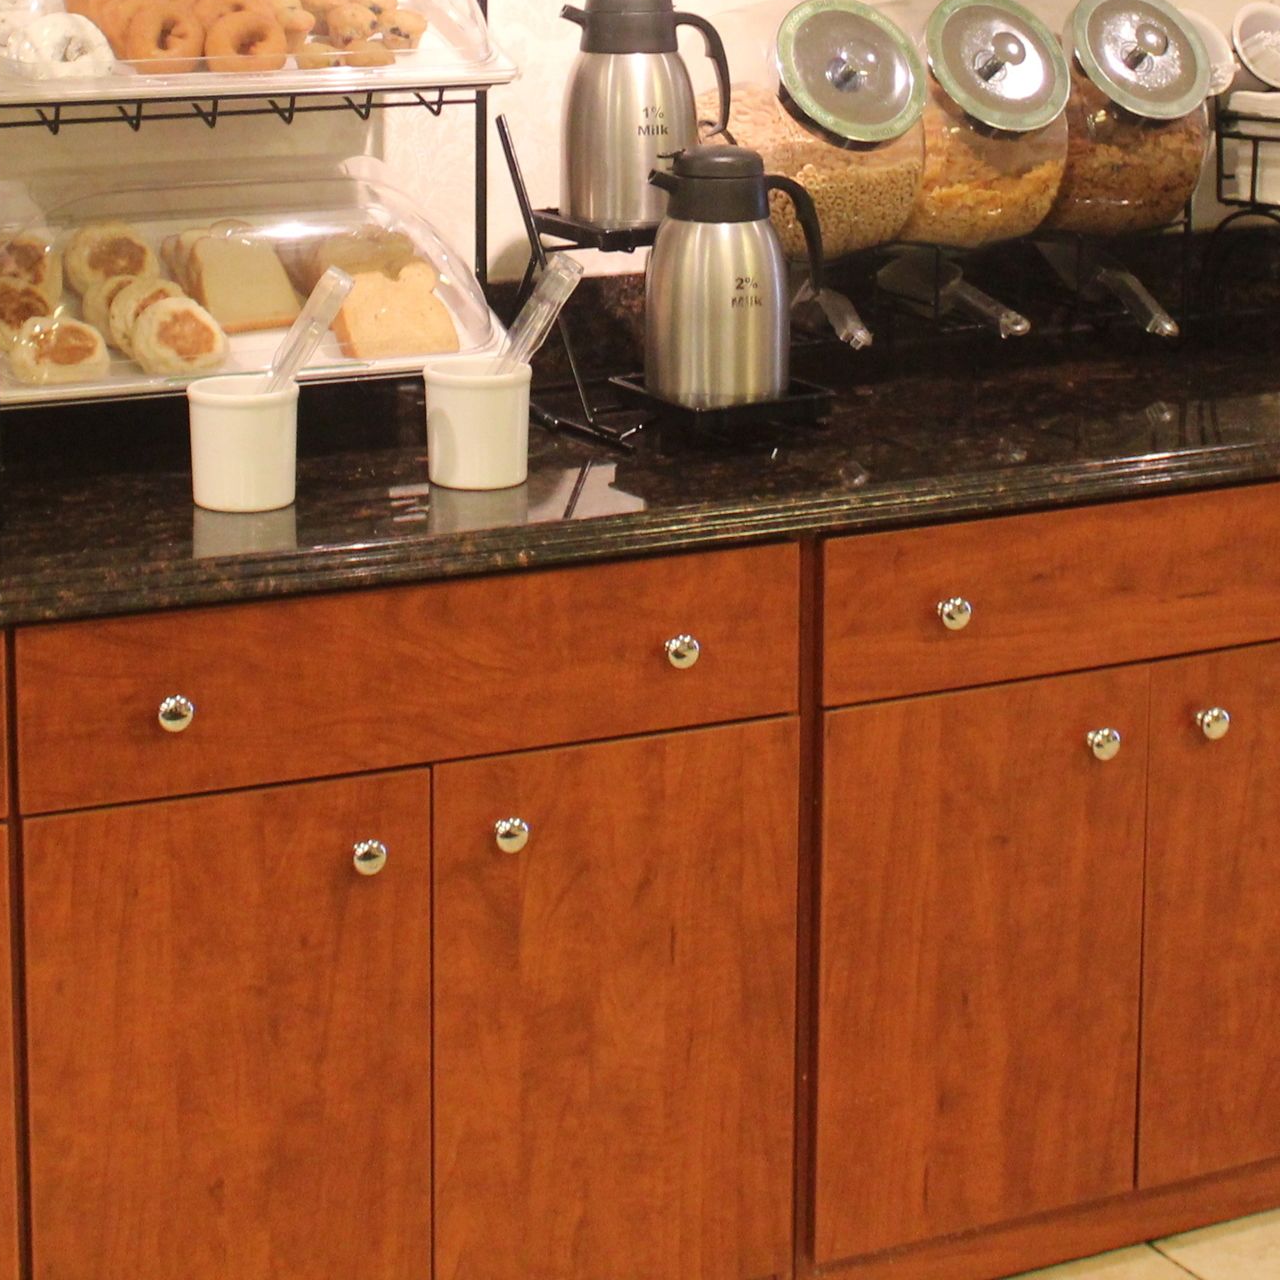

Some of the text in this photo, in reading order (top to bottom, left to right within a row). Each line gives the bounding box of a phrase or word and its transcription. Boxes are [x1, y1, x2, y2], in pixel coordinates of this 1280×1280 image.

[642, 106, 665, 119] 1%
[637, 124, 670, 136] Milk
[735, 277, 758, 290] 2%
